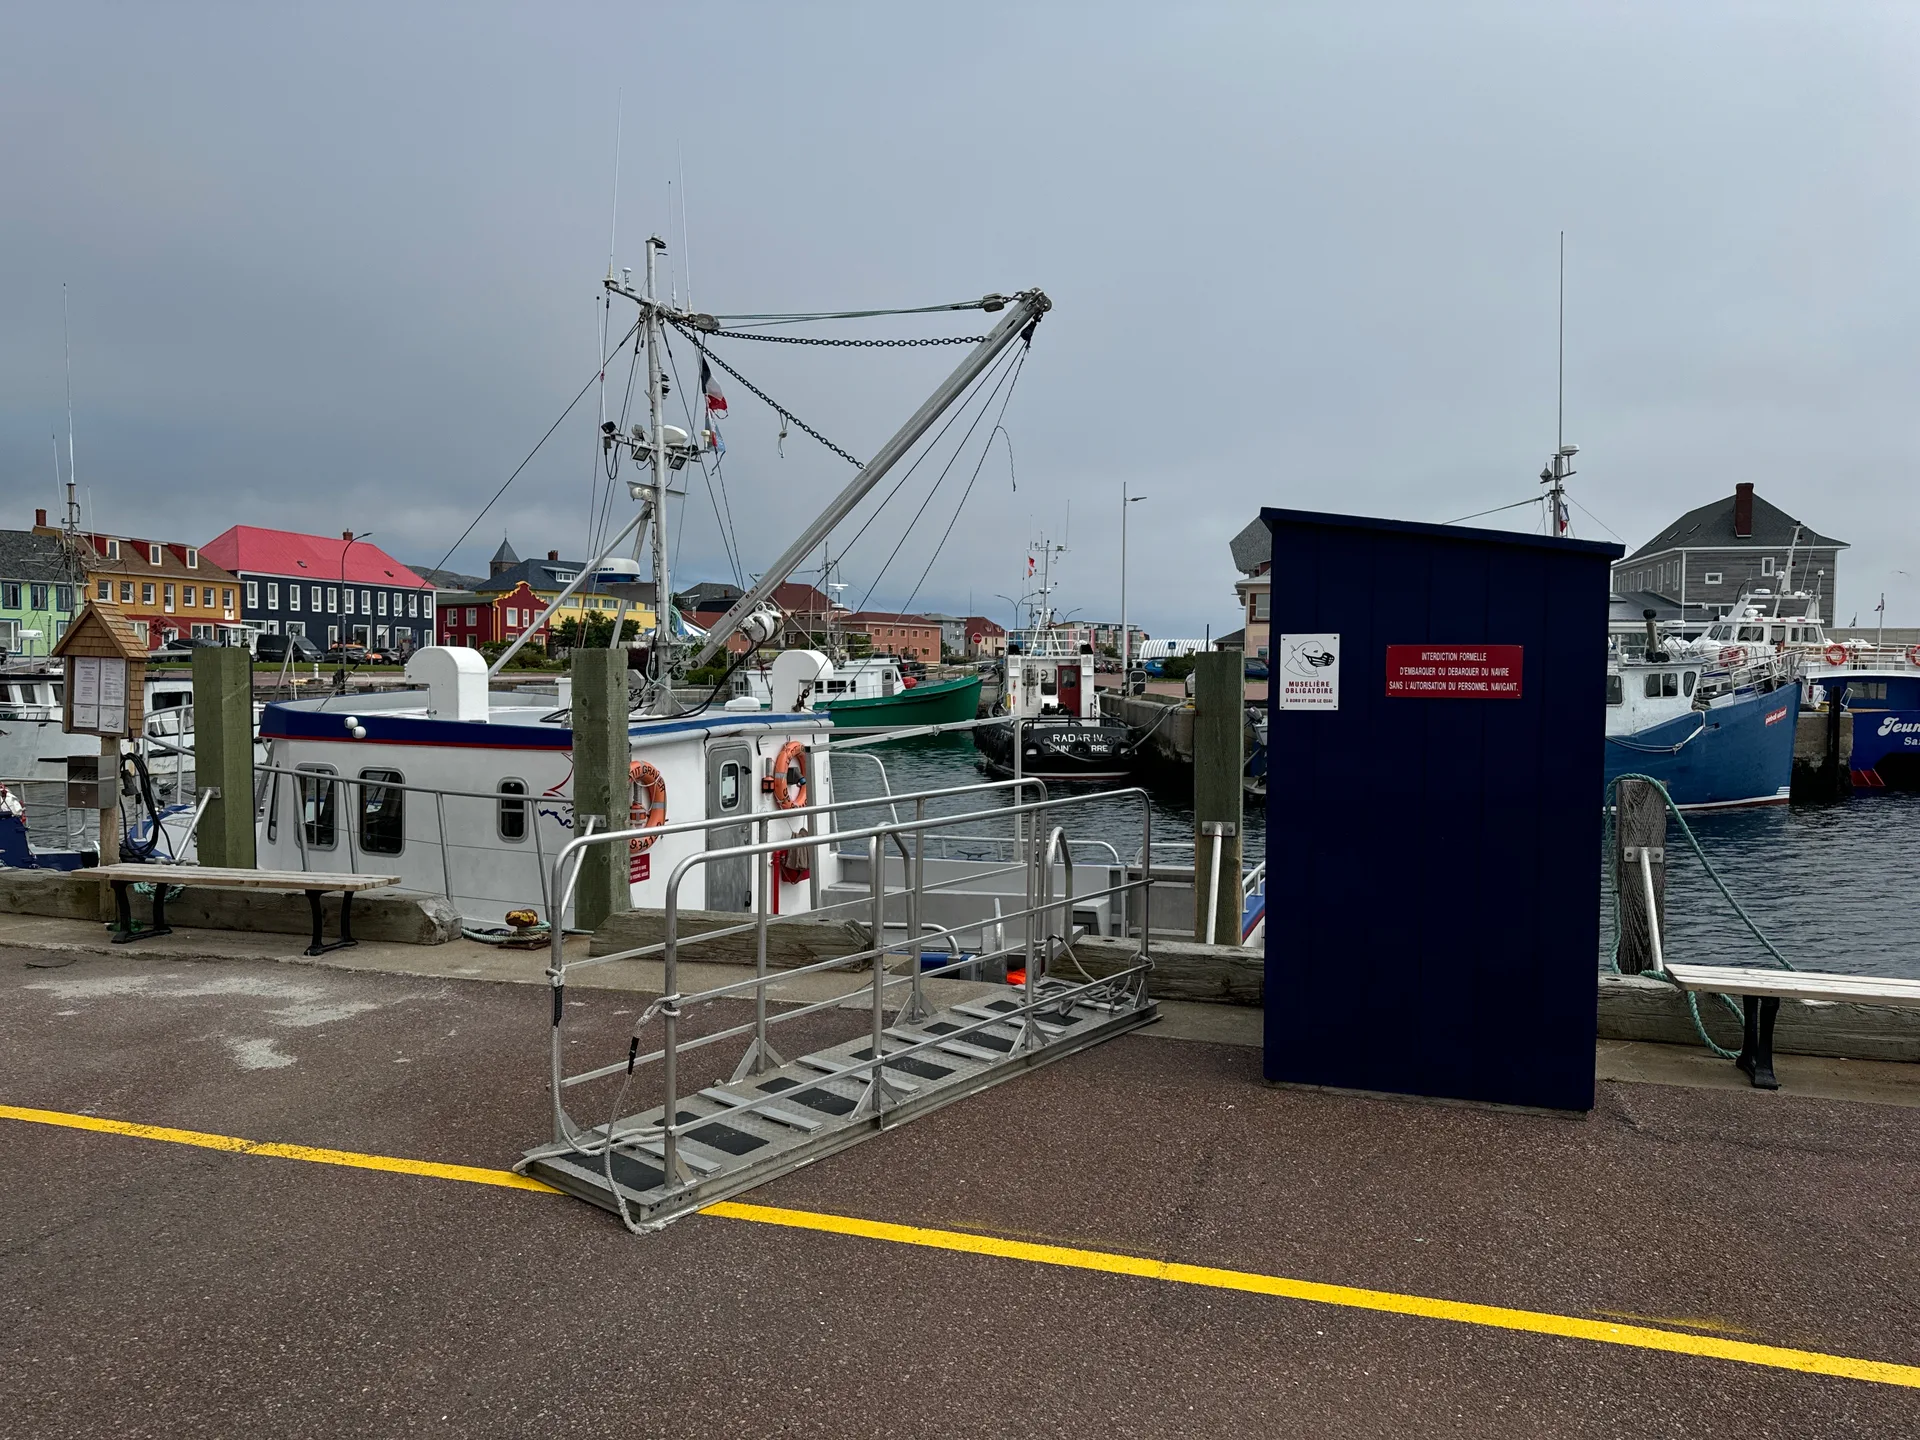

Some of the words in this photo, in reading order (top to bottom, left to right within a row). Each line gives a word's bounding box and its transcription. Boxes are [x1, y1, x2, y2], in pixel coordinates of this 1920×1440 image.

[1421, 652, 1458, 661] INTERDICTION
[1459, 652, 1487, 661] FORMELLE
[1399, 666, 1436, 676] D'EMBARQUER
[1438, 667, 1446, 676] OU
[1447, 667, 1480, 676] DEBARQUER
[1481, 667, 1489, 676] DU
[1490, 667, 1510, 676] NAVIRE
[1389, 681, 1403, 690] SANS
[1405, 681, 1447, 690] L'AUTORISATION
[1448, 682, 1456, 690] DU
[1457, 682, 1489, 691] PERSONNEL
[1052, 733, 1091, 742] RADAR
[1093, 733, 1104, 742] IV
[1049, 744, 1071, 752] SAIN
[642, 765, 665, 792] GRAVER
